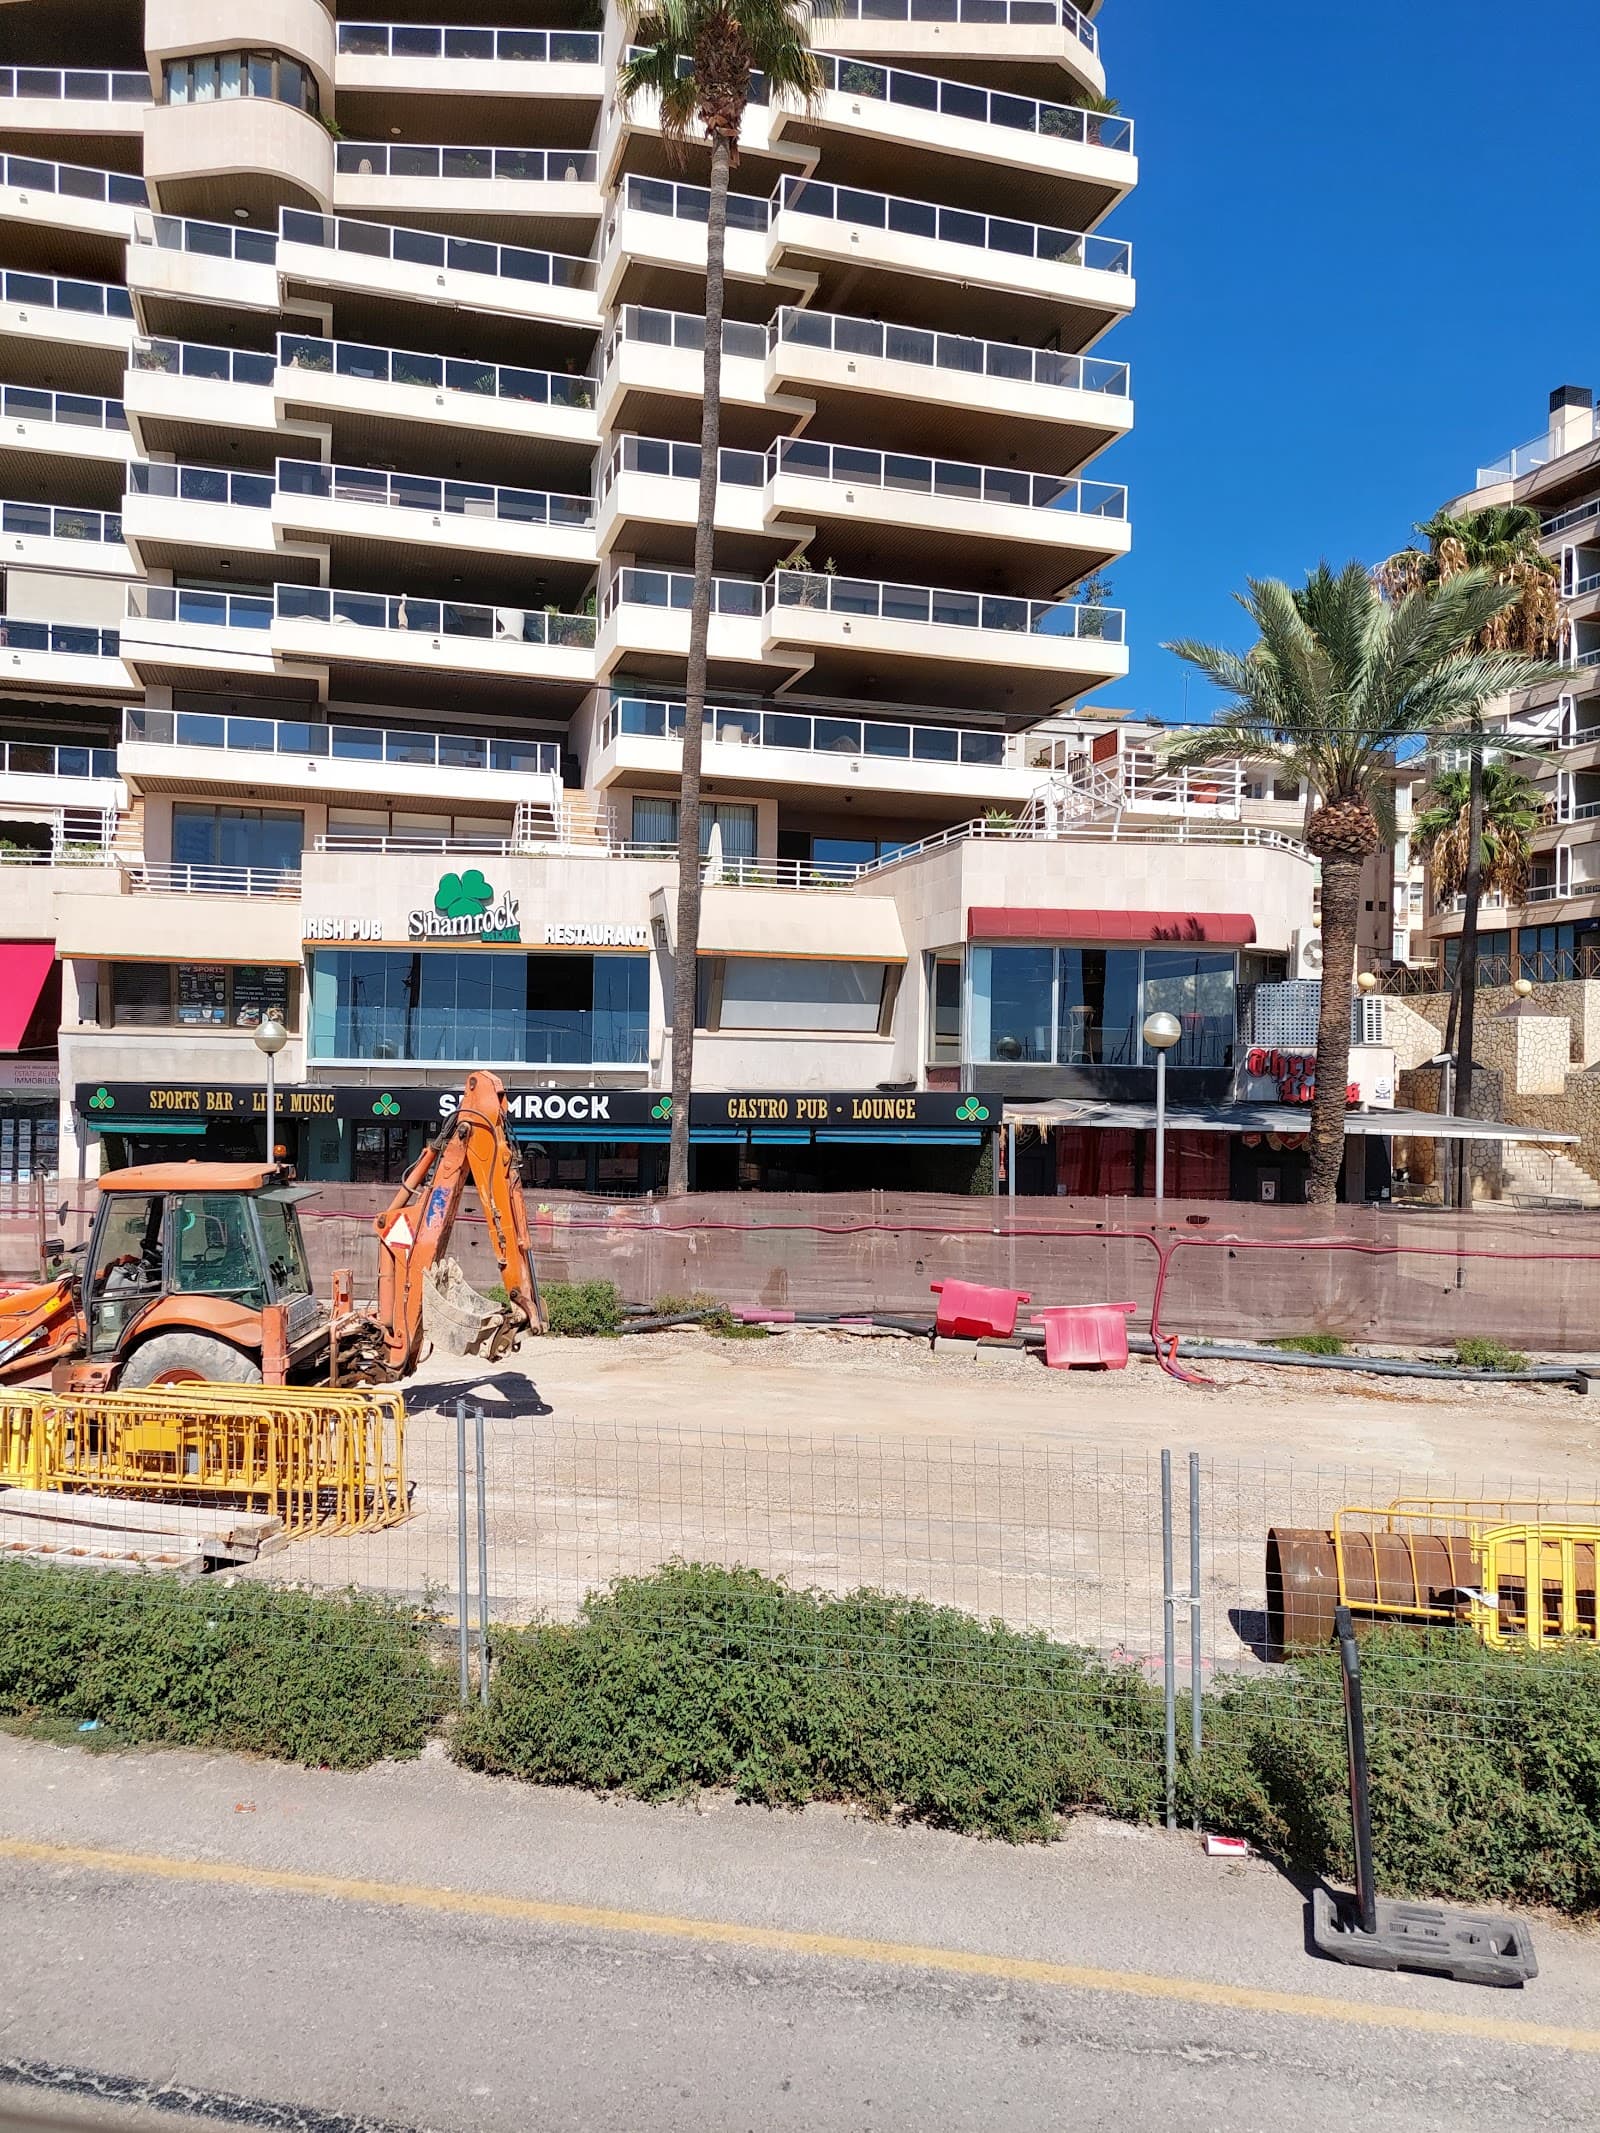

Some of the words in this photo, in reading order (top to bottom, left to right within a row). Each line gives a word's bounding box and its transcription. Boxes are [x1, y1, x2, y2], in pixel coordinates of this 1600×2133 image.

[408, 890, 519, 936] Shamrock
[303, 918, 345, 939] IRISH
[350, 918, 382, 940] PUB
[544, 923, 647, 946] RESTAURANT
[1247, 1048, 1317, 1082] Thre
[150, 1090, 199, 1110] SPORTS
[206, 1092, 233, 1111] BAR
[252, 1093, 284, 1112] LIE
[290, 1094, 335, 1113] MUSIC
[439, 1093, 611, 1120] SMROCK
[727, 1098, 789, 1119] GASTRO
[795, 1098, 828, 1119] PUB
[852, 1098, 917, 1120] LOUNGE
